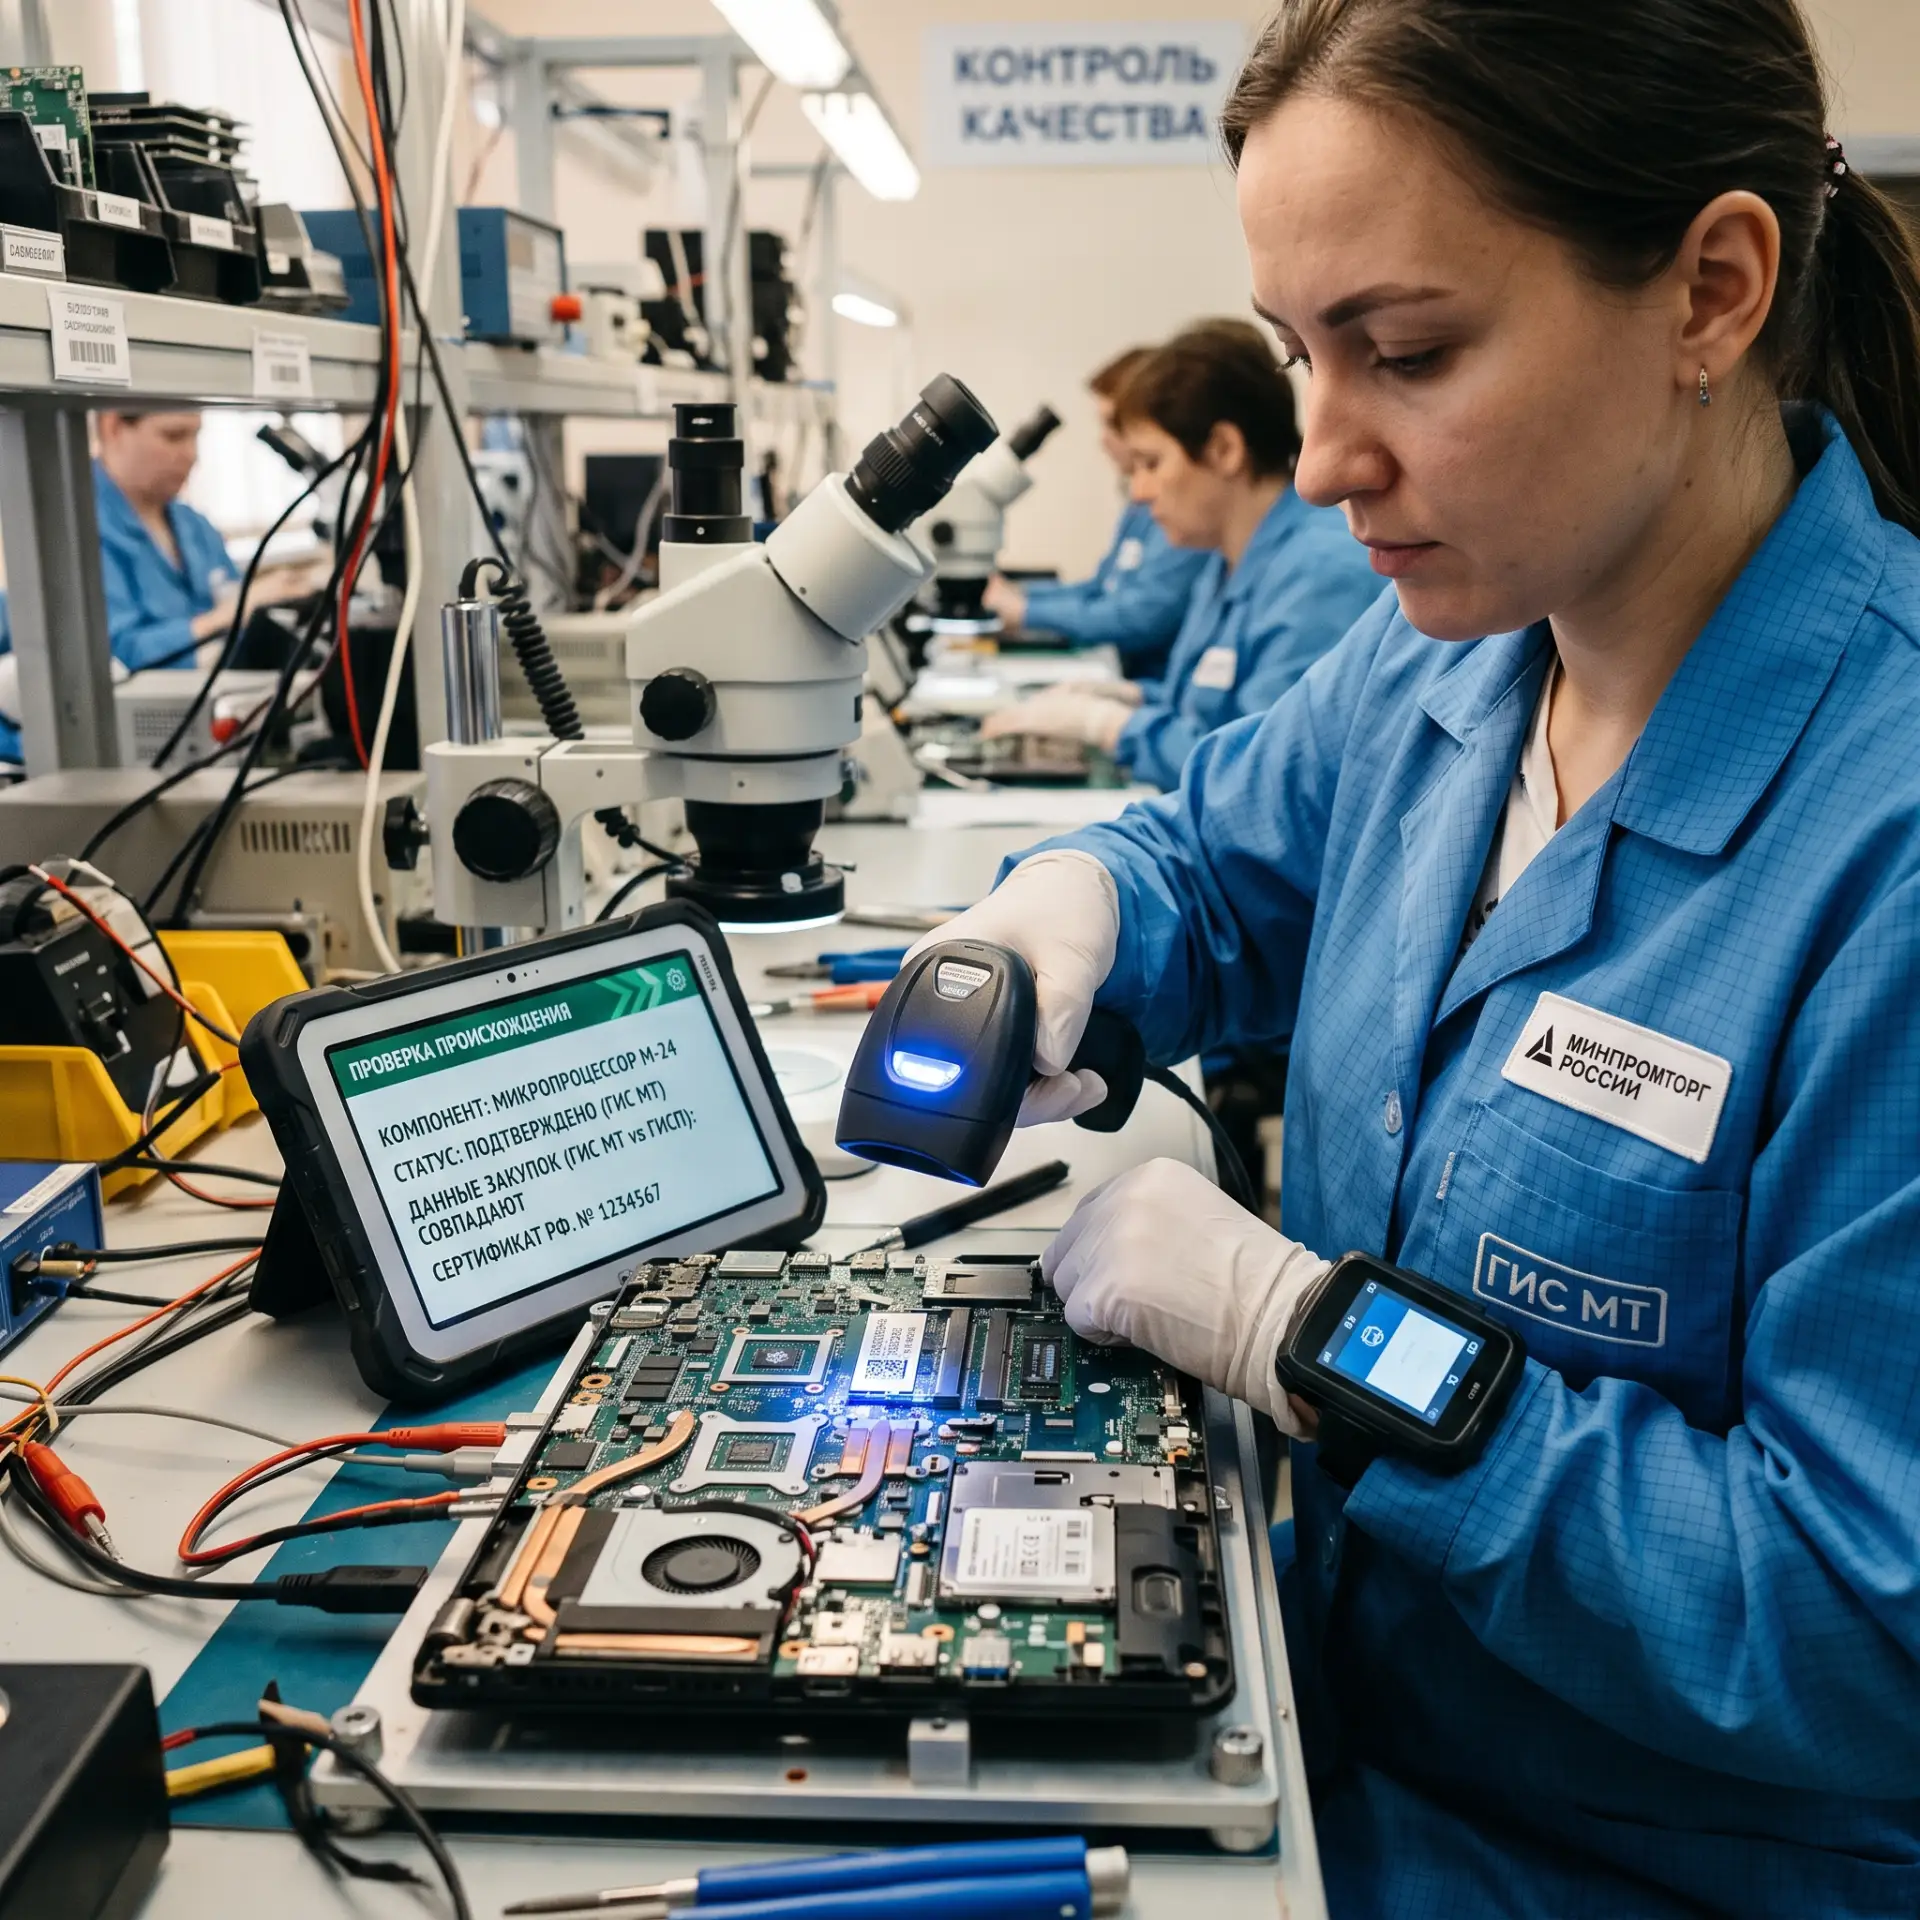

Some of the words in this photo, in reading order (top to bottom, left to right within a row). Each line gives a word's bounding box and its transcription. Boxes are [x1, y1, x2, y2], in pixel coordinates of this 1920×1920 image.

[955, 45, 1217, 84] КОНТРОЛЬ
[962, 104, 1209, 141] КАЧЕСТВА
[349, 1043, 436, 1082] ПРОВЕРКА
[435, 1001, 573, 1057] ПРОИСХОЖДЕНИЯ
[1558, 1054, 1642, 1101] РОССИИ
[1566, 1033, 1712, 1103] МИНПРОМТОРГ
[378, 1098, 492, 1148] КОМПОНЕНТ:
[491, 1051, 637, 1112] МИКРОПРОЦЕССОР
[639, 1039, 678, 1067] М-24
[394, 1146, 464, 1183] СТАТУС:
[464, 1101, 598, 1162] ПОДТВЕРЖДЕНО
[600, 1088, 636, 1120] (ГИС
[635, 1080, 667, 1109] МТ)
[408, 1179, 483, 1224] ДАННЫЕ
[483, 1152, 562, 1193] ЗАКУПОК
[564, 1139, 600, 1171] (ГИС
[600, 1130, 625, 1155] МТ
[628, 1127, 647, 1145] vs
[646, 1108, 697, 1139] ГИСП):
[418, 1192, 526, 1246] СОВПАДАЮТ
[432, 1226, 545, 1282] СЕРТИФИКАТ
[545, 1218, 577, 1241] РФ.
[576, 1208, 595, 1230] №
[598, 1182, 662, 1221] 1234567
[1486, 1254, 1568, 1314] ГИС
[1581, 1289, 1651, 1332] МТ
